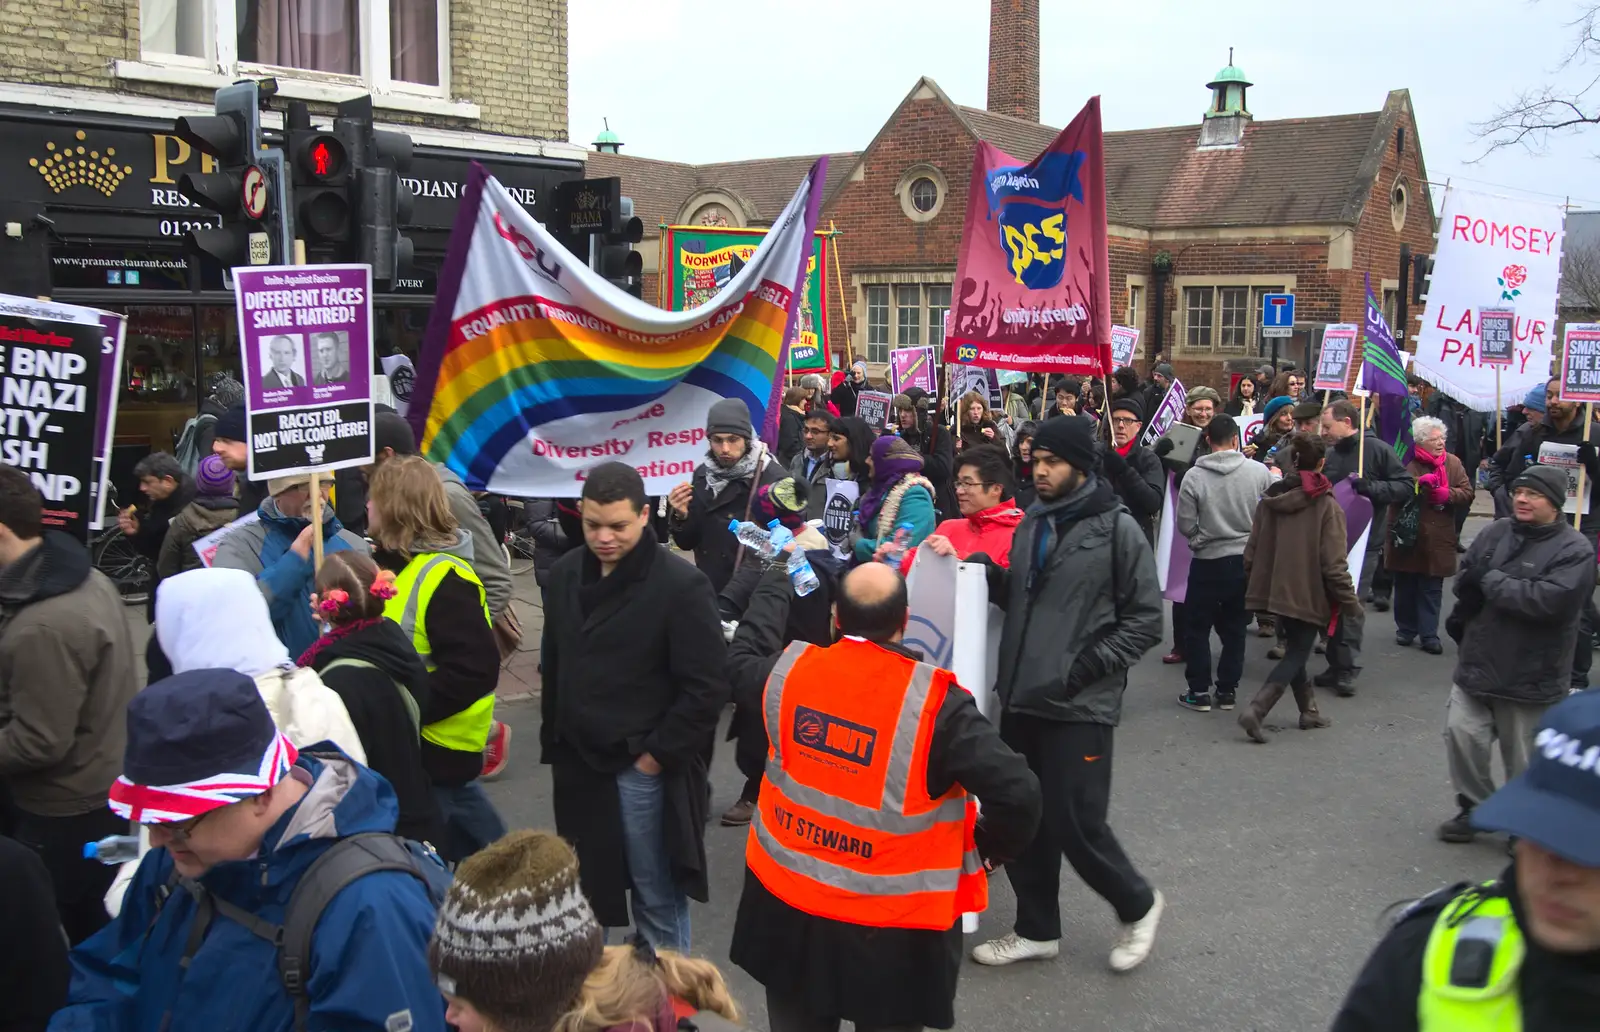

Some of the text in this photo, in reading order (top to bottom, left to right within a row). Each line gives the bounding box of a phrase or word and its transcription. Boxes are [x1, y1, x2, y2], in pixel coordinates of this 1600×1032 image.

[570, 210, 602, 224] PRANA
[1451, 214, 1557, 256] ROMSEY
[250, 239, 268, 250] Except
[53, 256, 188, 269] www.pranarestaurant.co.uk
[251, 250, 268, 261] cycles
[284, 274, 313, 287] Against
[312, 273, 340, 284] Fascism
[395, 279, 424, 288] IVERY
[244, 287, 365, 311] DIFFERENT FACES
[253, 306, 356, 329] SAME HATRED!
[460, 303, 536, 341] EQUALITY
[536, 302, 613, 334] THROUGH
[1002, 303, 1088, 329] Unity is strength
[1436, 304, 1547, 345] LAUR
[1482, 318, 1508, 331] SMASH
[1112, 333, 1132, 345] SMASH
[1325, 337, 1349, 350] SMASH
[1497, 330, 1512, 342] EDL
[794, 347, 815, 361] 1886
[957, 346, 978, 361] pcs
[1112, 350, 1126, 359] BNP
[1120, 343, 1132, 353] EDL
[11, 346, 88, 380] BNP
[979, 350, 1000, 362] Public
[999, 353, 1012, 363] and
[1044, 353, 1073, 364] Services
[1440, 338, 1532, 375] PAY
[1568, 355, 1592, 370] THE
[1566, 369, 1577, 384] &
[3, 377, 87, 413] NAZI
[860, 399, 884, 410] SMASH
[278, 408, 343, 430] RACIST EDL
[865, 415, 879, 425] BNP
[872, 409, 885, 419] EDL
[254, 420, 369, 450] NOT WELCOME HERE!
[531, 438, 635, 459] Diversity
[22, 470, 82, 502] NP
[826, 514, 851, 531] UNITE
[825, 722, 873, 759] NUT
[796, 817, 873, 859] STEWARD
